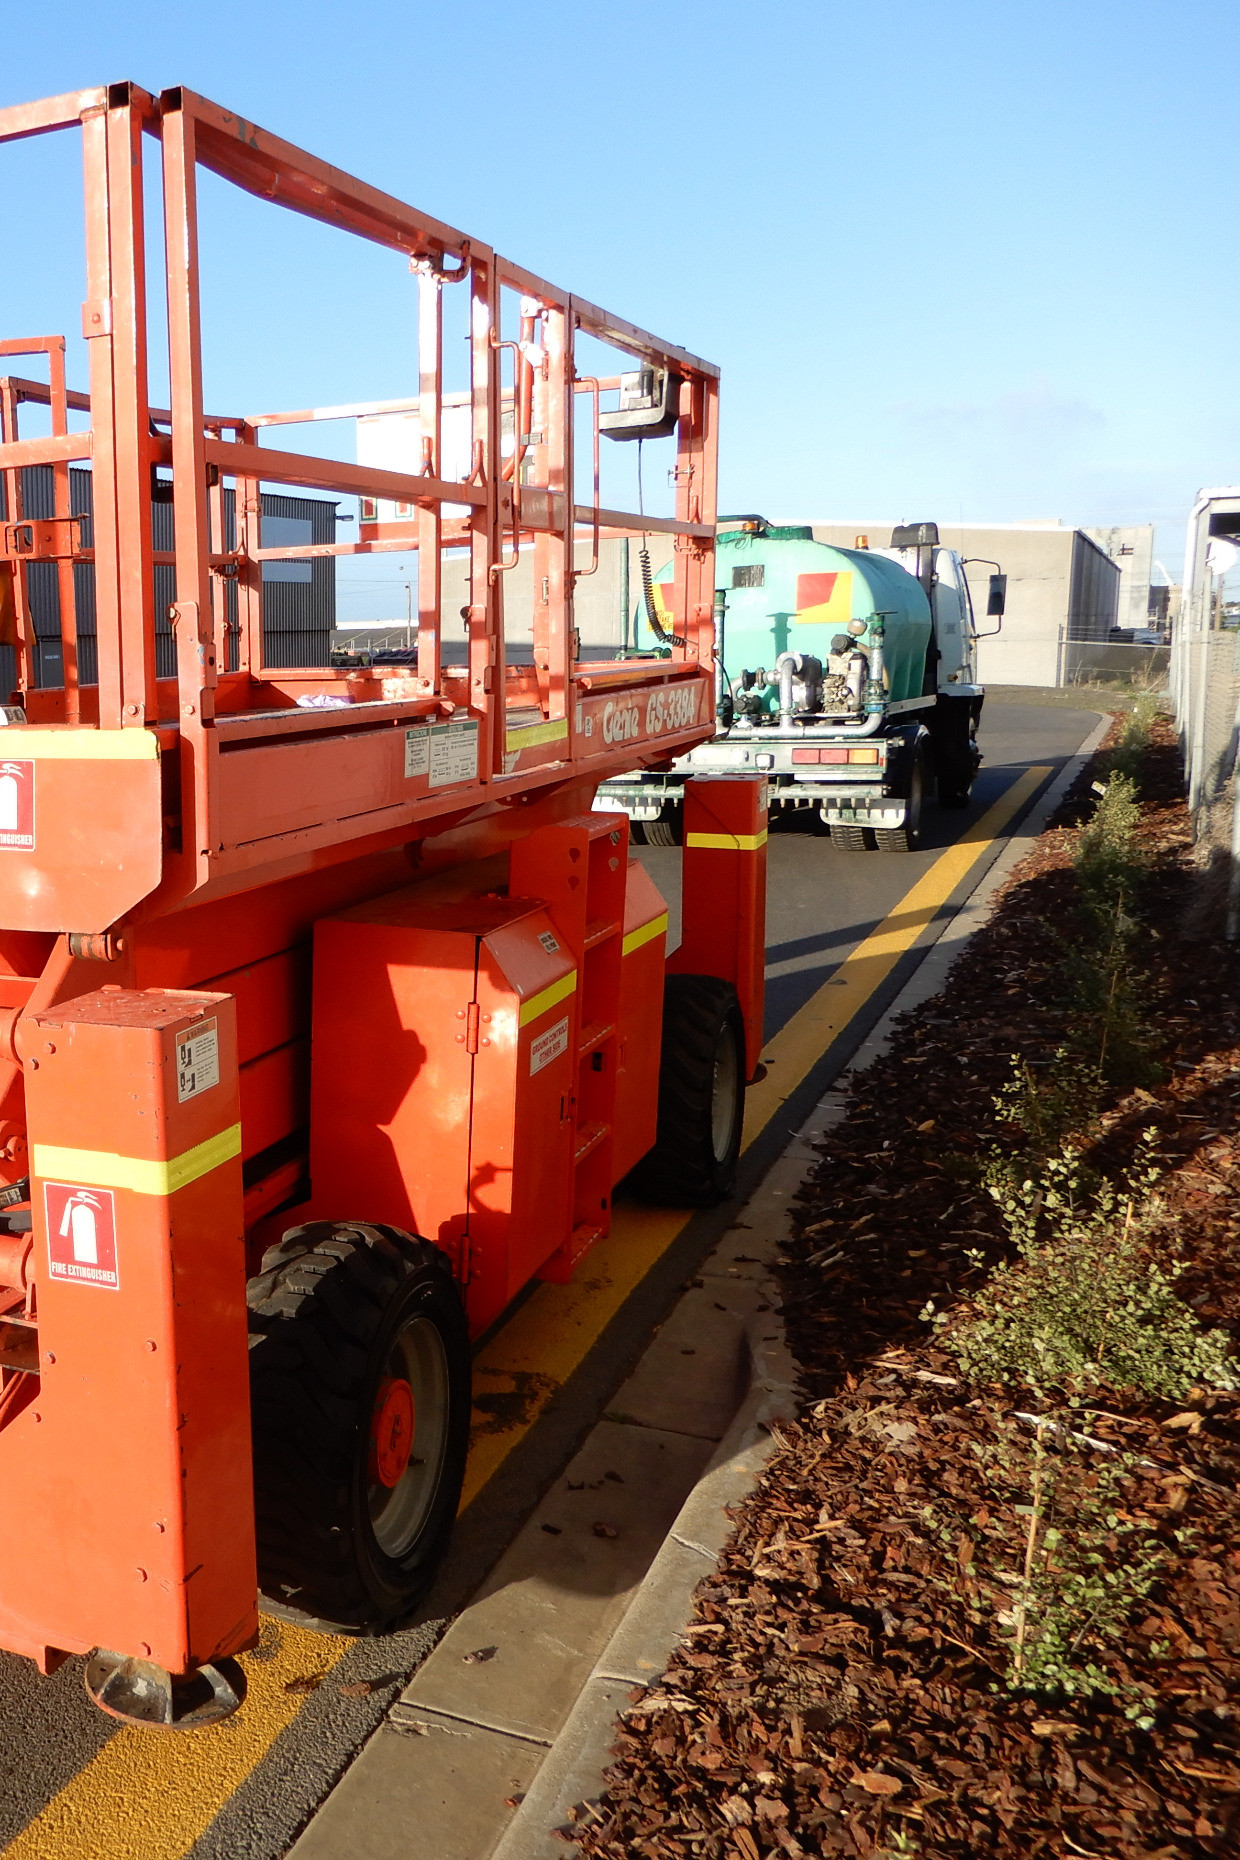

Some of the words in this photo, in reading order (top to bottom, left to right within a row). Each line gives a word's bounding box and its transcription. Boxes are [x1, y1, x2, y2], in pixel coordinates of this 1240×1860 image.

[602, 699, 639, 744] Genie
[645, 686, 696, 734] GS-3384
[51, 1261, 67, 1275] FIRE
[67, 1264, 116, 1283] EXTINGUISHER
